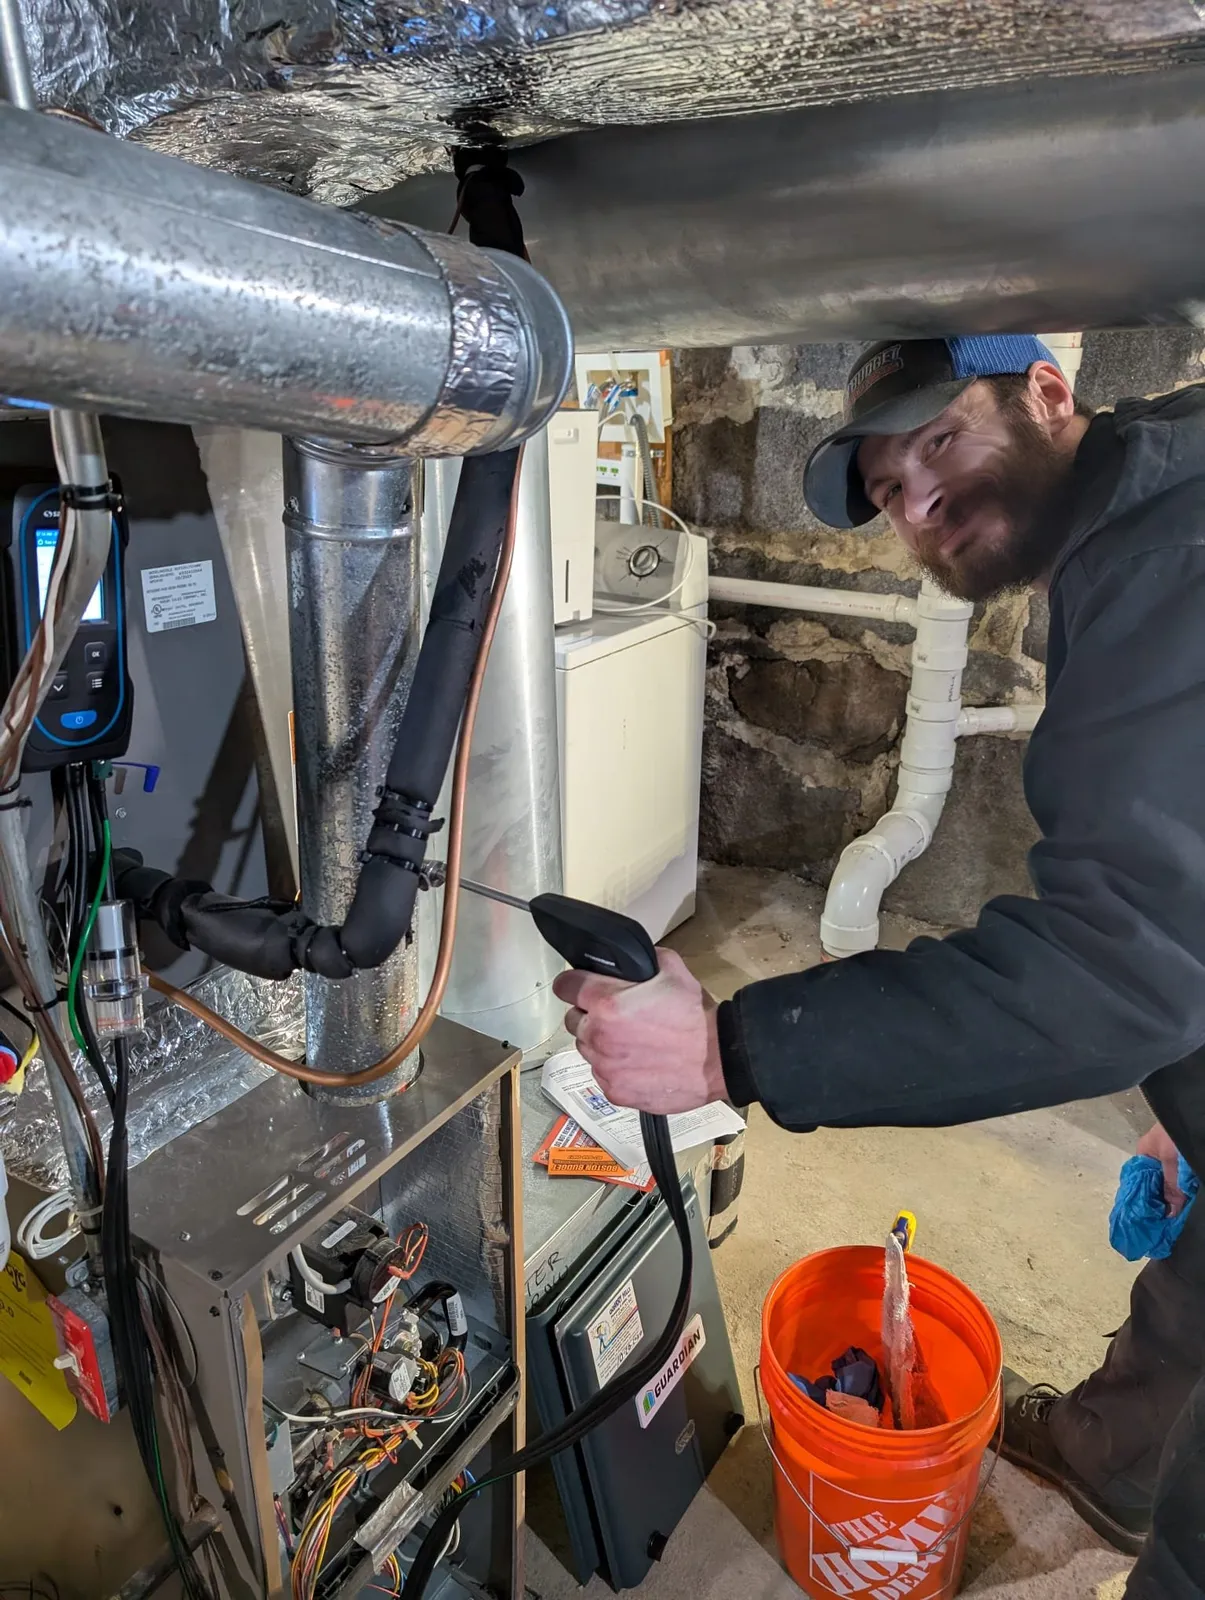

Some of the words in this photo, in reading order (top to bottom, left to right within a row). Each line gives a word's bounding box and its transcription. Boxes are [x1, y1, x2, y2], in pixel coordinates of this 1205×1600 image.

[91, 650, 101, 659] OK
[551, 1162, 584, 1172] BUDGET
[585, 1163, 619, 1172] BOSTON
[653, 1328, 701, 1399] GUARDIAN
[829, 1510, 897, 1544] THE
